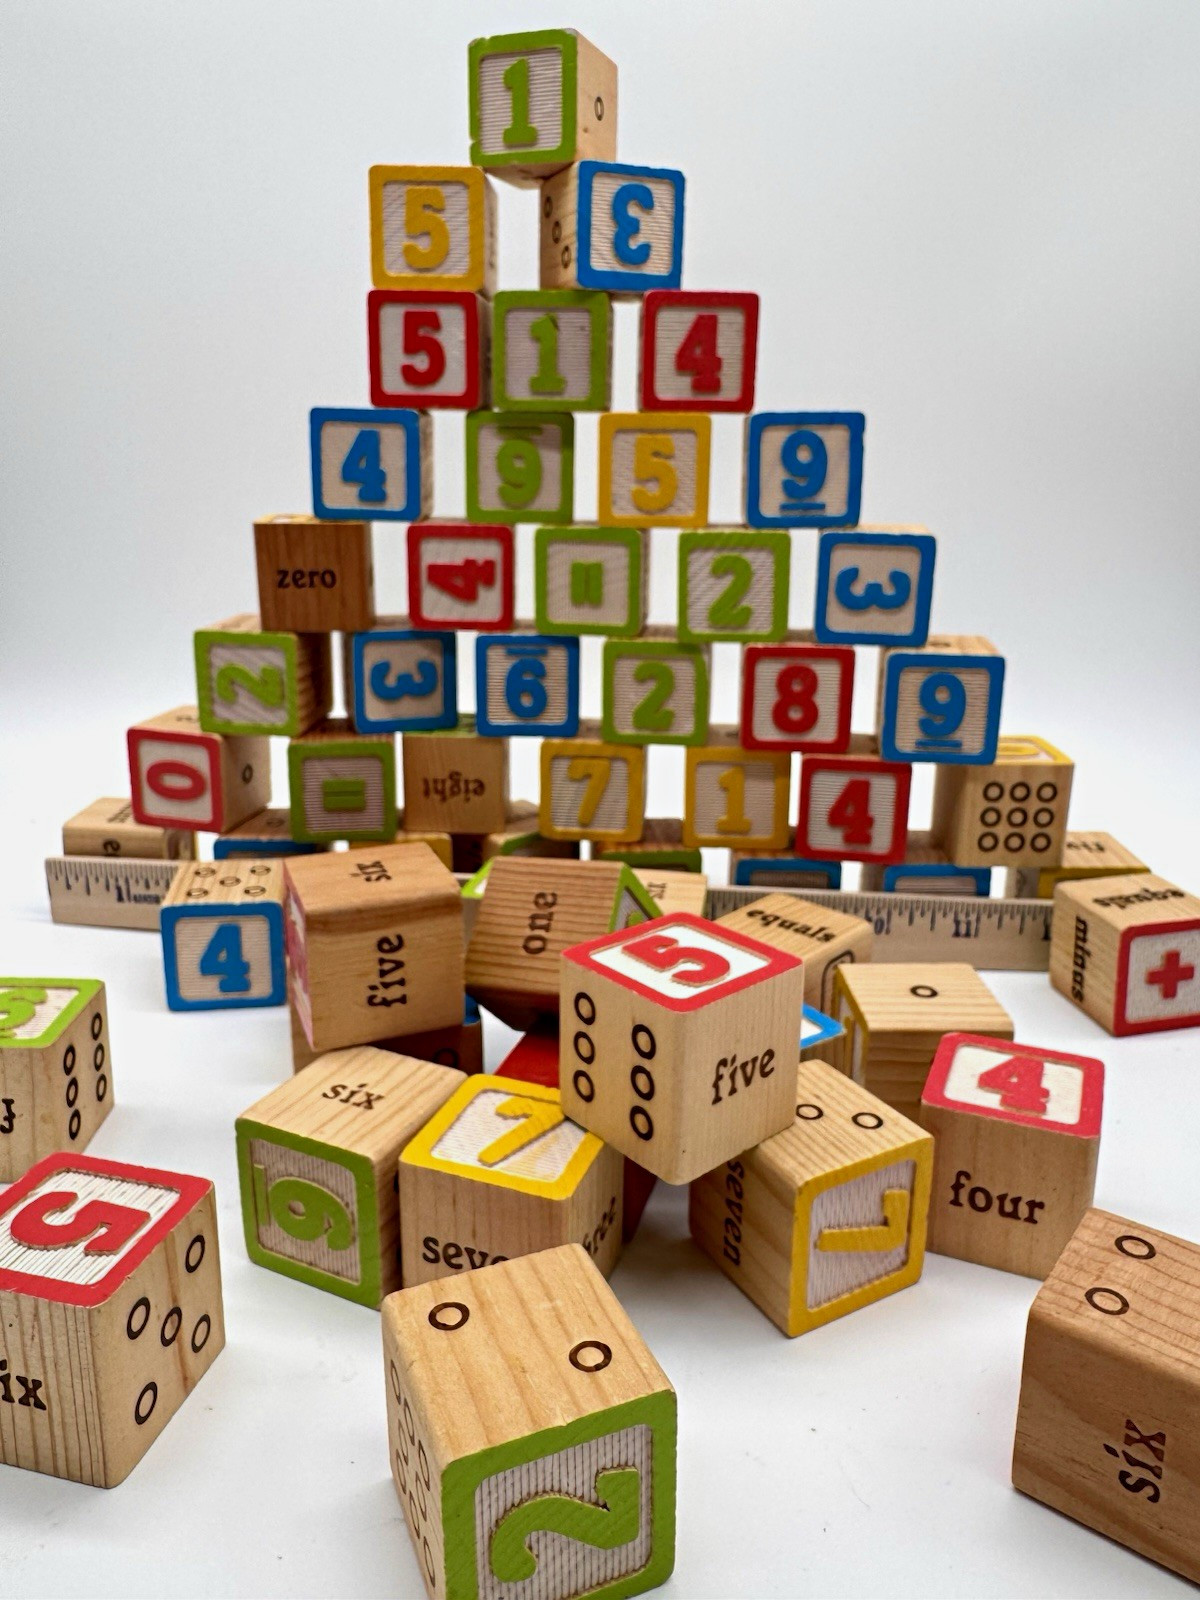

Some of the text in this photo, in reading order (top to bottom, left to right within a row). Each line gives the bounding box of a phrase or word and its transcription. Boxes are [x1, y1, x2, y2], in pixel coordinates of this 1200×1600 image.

[503, 58, 537, 146] 1
[403, 187, 450, 269] 5
[402, 311, 445, 386] 5
[529, 313, 566, 393] 1
[674, 315, 721, 393] 4
[342, 429, 387, 502] 4
[631, 434, 679, 513] 5
[781, 429, 828, 500] 9
[276, 569, 337, 589] zero
[427, 558, 496, 602] 4
[708, 554, 753, 629] 2
[632, 661, 676, 732] 2
[772, 665, 819, 735] 8
[918, 672, 967, 738] 9
[422, 771, 486, 802] eight
[568, 757, 611, 826] 7
[716, 766, 751, 833] 1
[828, 779, 874, 845] 4
[351, 861, 392, 883] six
[522, 891, 559, 956] one
[745, 907, 837, 943] equals
[200, 923, 251, 994] 4
[367, 934, 408, 1008] five
[622, 935, 731, 987] 5
[1071, 915, 1092, 1003] minus
[322, 1082, 385, 1112] six
[710, 1047, 776, 1106] five
[977, 1054, 1049, 1116] 4
[495, 1094, 567, 1168] 7
[10, 1190, 151, 1257] 5
[722, 1160, 746, 1266] seven
[815, 1188, 909, 1252] 7
[949, 1170, 1045, 1227] four
[422, 1236, 510, 1269] sev
[0, 1358, 47, 1412] ix
[1102, 1417, 1167, 1504] six
[490, 1468, 640, 1584] 2
